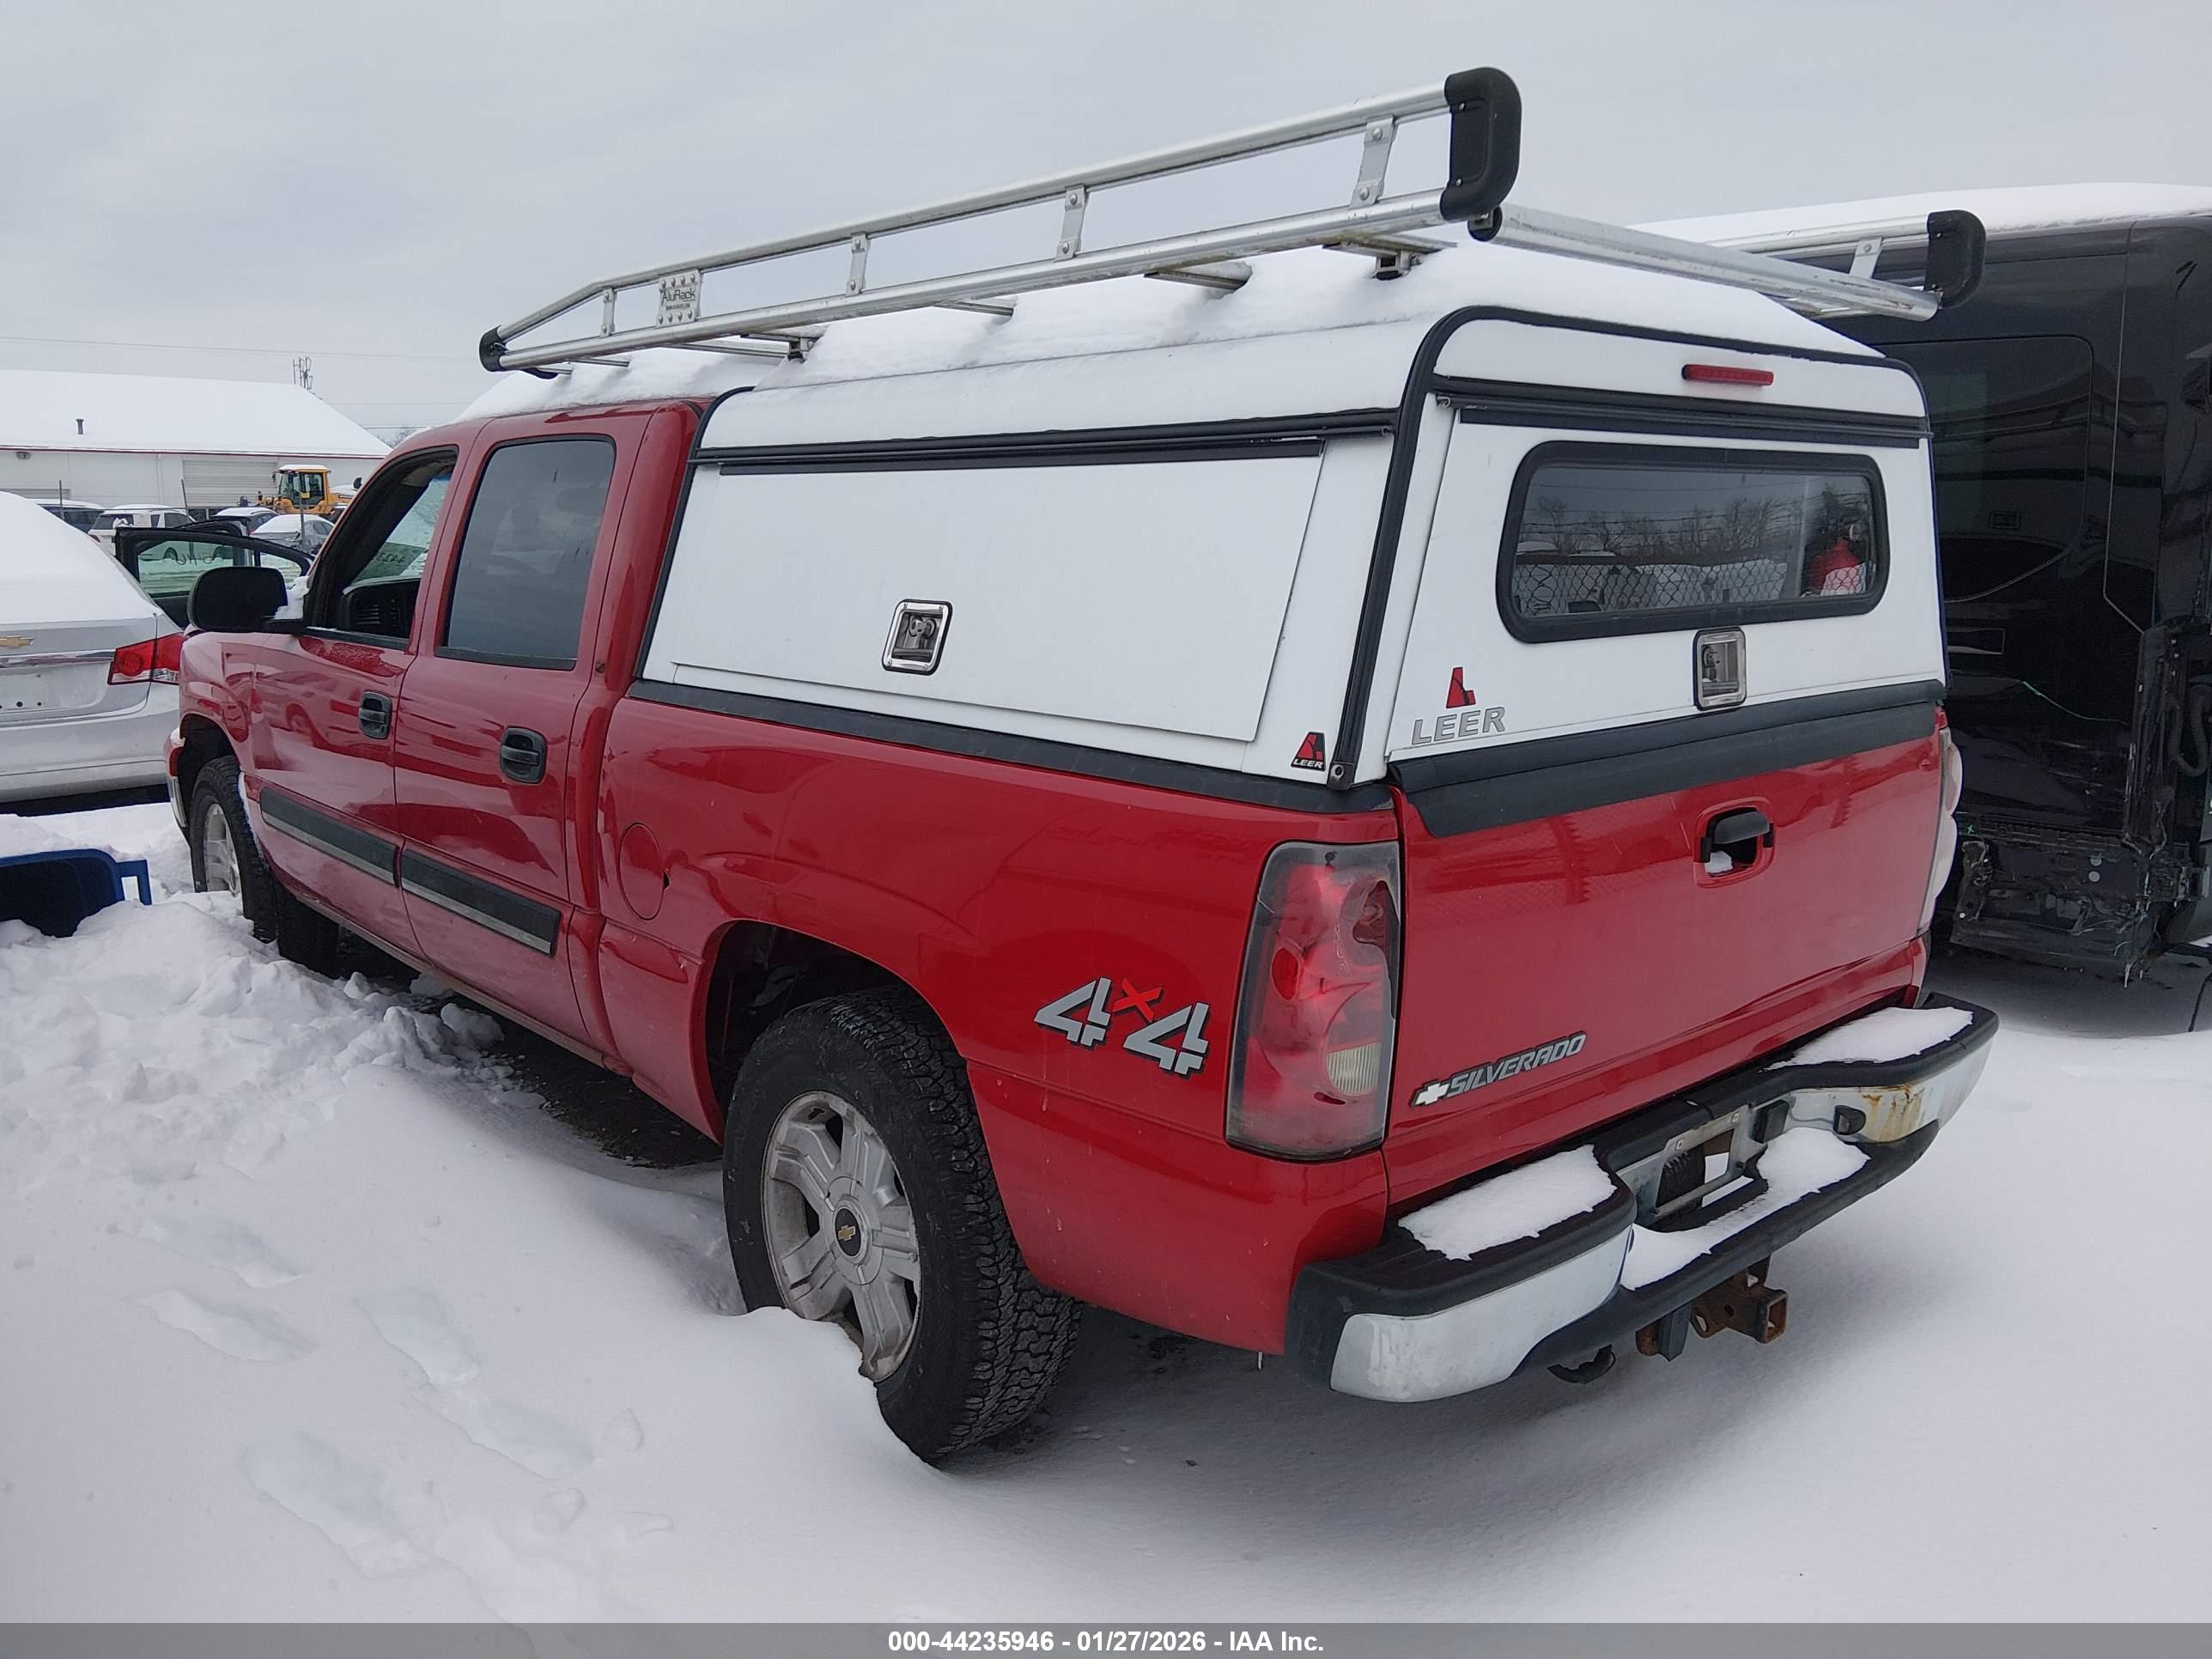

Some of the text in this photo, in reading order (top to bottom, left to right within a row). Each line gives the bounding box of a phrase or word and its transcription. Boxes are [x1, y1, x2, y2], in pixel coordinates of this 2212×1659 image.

[1411, 706, 1506, 745] LEER
[1293, 757, 1324, 769] LEER
[1446, 1033, 1588, 1098] SILVERADO
